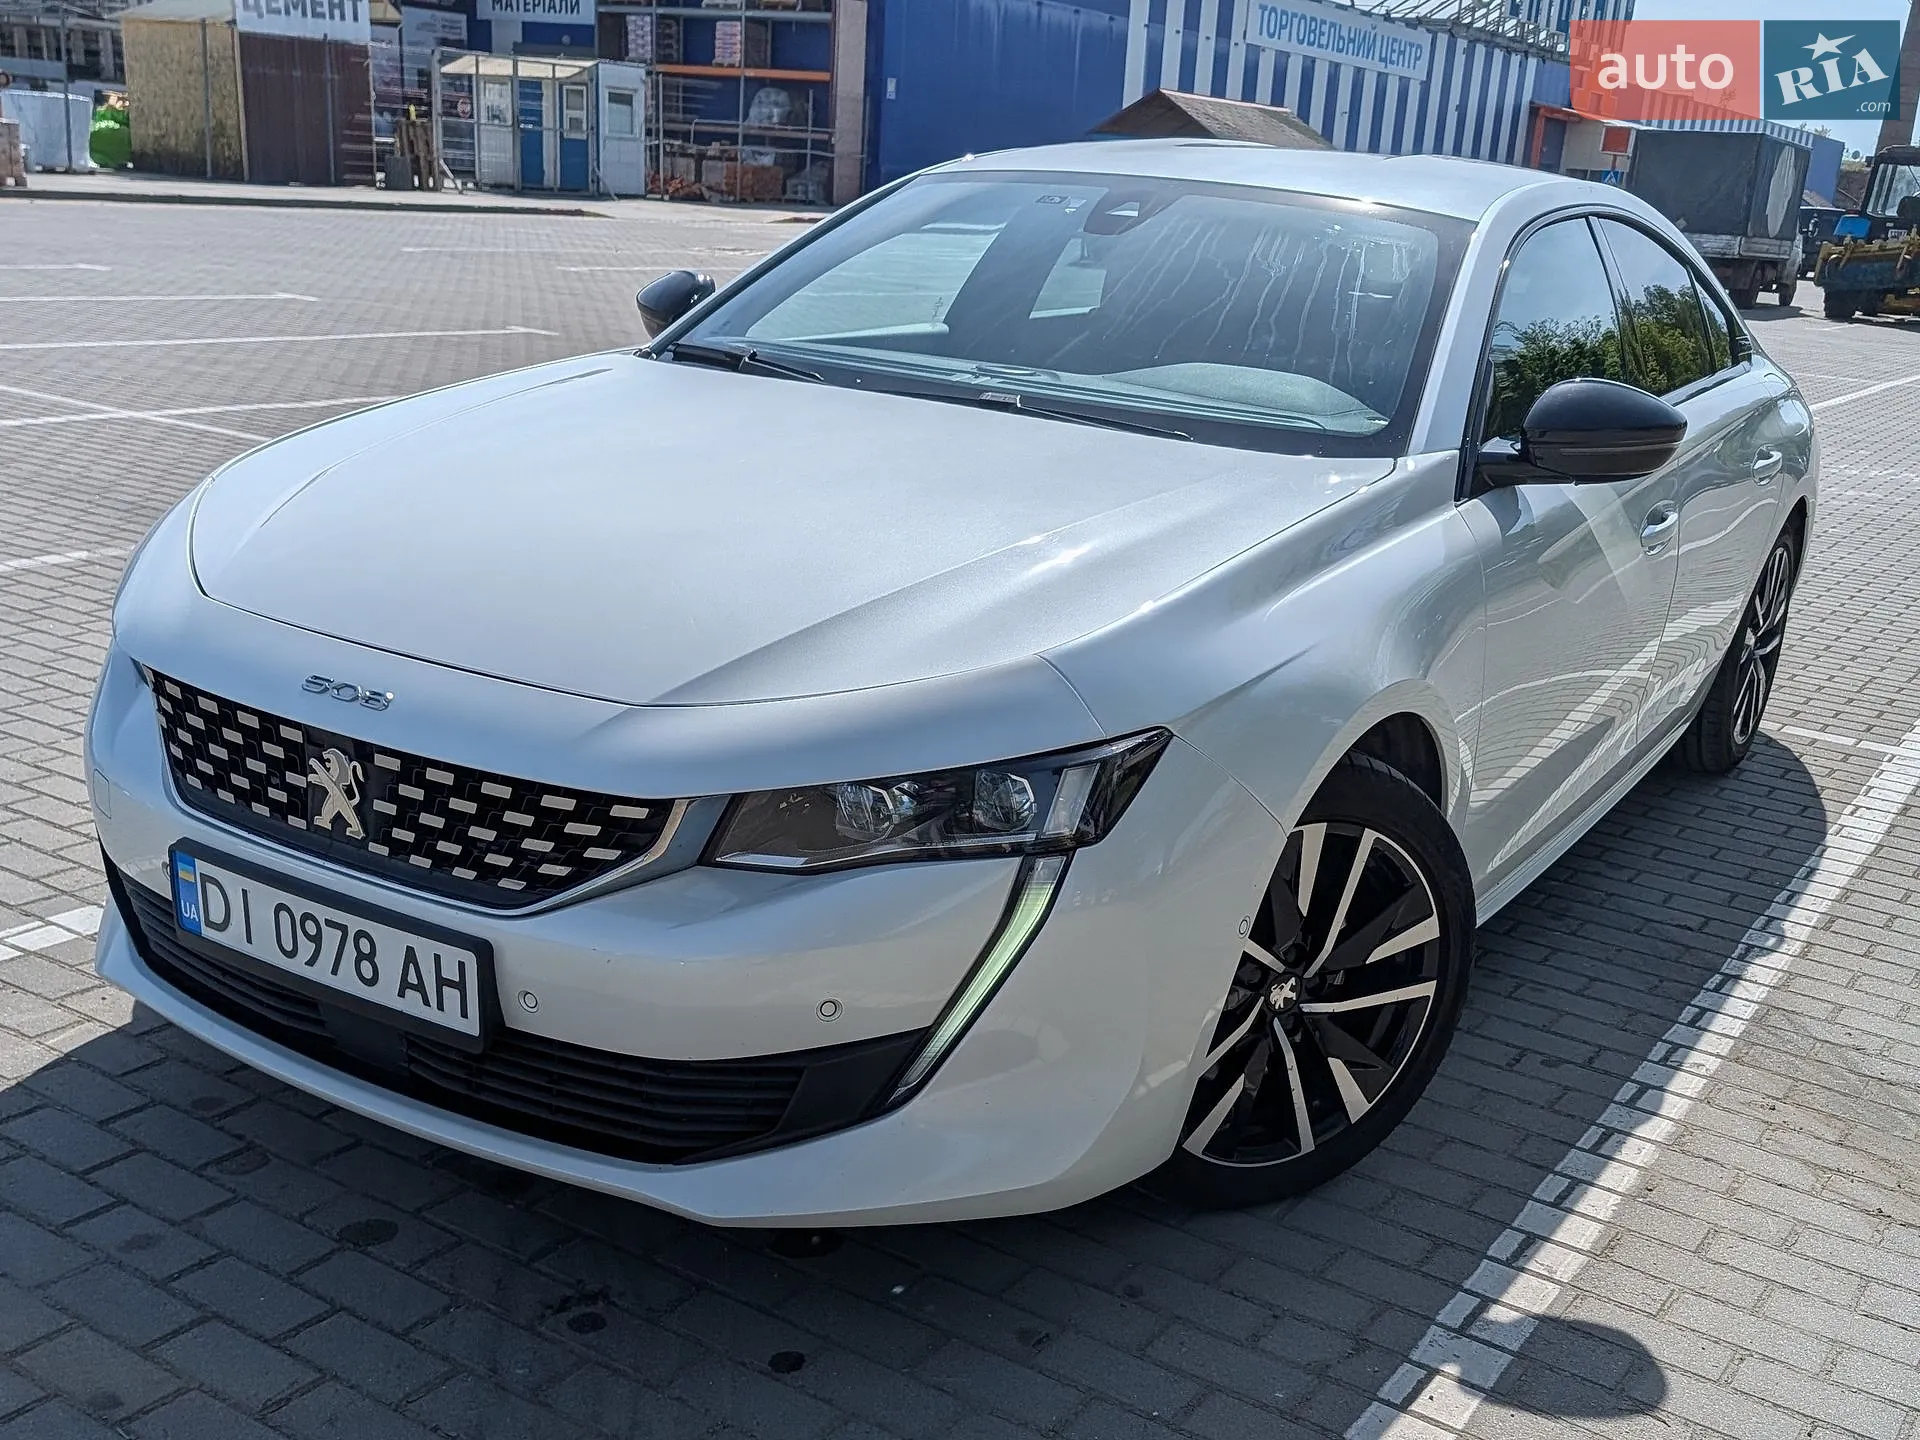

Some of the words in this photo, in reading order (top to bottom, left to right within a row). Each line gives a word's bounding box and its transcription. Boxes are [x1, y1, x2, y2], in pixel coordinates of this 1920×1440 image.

[242, 0, 363, 23] ЦЕМЕНТ
[491, 0, 580, 15] МАТЕРІАЛИ
[1258, 4, 1378, 61] ТОРГОВЕЛЬНИЙ
[1378, 35, 1423, 70] ЦЕНТР
[301, 674, 394, 711] 508
[181, 899, 199, 921] UA
[200, 872, 253, 945] DI
[273, 902, 380, 987] 0978
[397, 945, 469, 1019] AH
